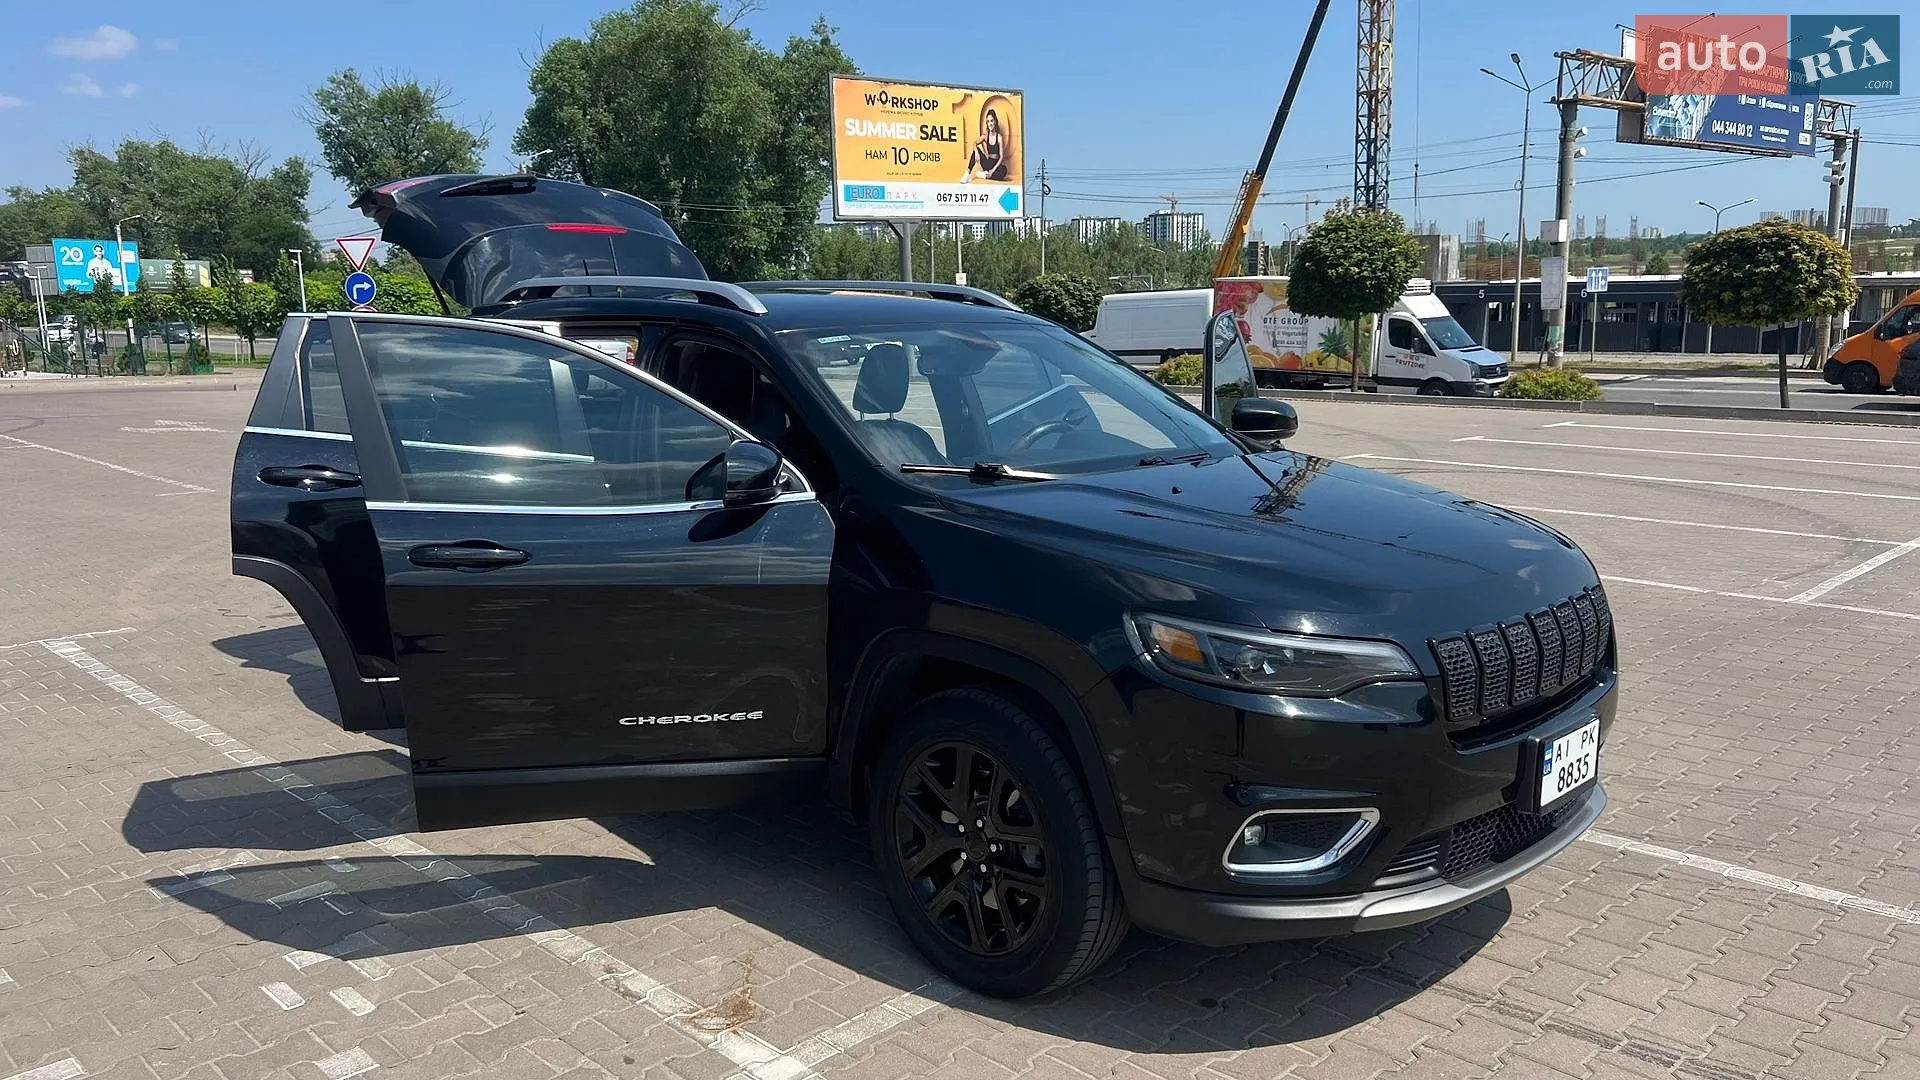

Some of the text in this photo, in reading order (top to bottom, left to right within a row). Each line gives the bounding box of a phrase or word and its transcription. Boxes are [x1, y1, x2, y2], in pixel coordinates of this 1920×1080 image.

[865, 90, 938, 111] WORKSHOP
[845, 118, 957, 142] SUMMER SALE
[1711, 119, 1724, 133] 044
[1737, 122, 1746, 137] 80
[1746, 124, 1753, 137] 12
[865, 147, 941, 165] НАМ 10 РОКІВ
[851, 187, 918, 200] EURO ПАРК
[936, 193, 989, 203] 067 517 11 47
[60, 246, 84, 262] 20
[1478, 290, 1485, 299] 5
[1581, 289, 1588, 298] 6
[1281, 317, 1309, 325] GROUP
[618, 710, 764, 726] CHEROKEE
[1555, 725, 1596, 763] AI PK
[1557, 753, 1589, 793] 8835
